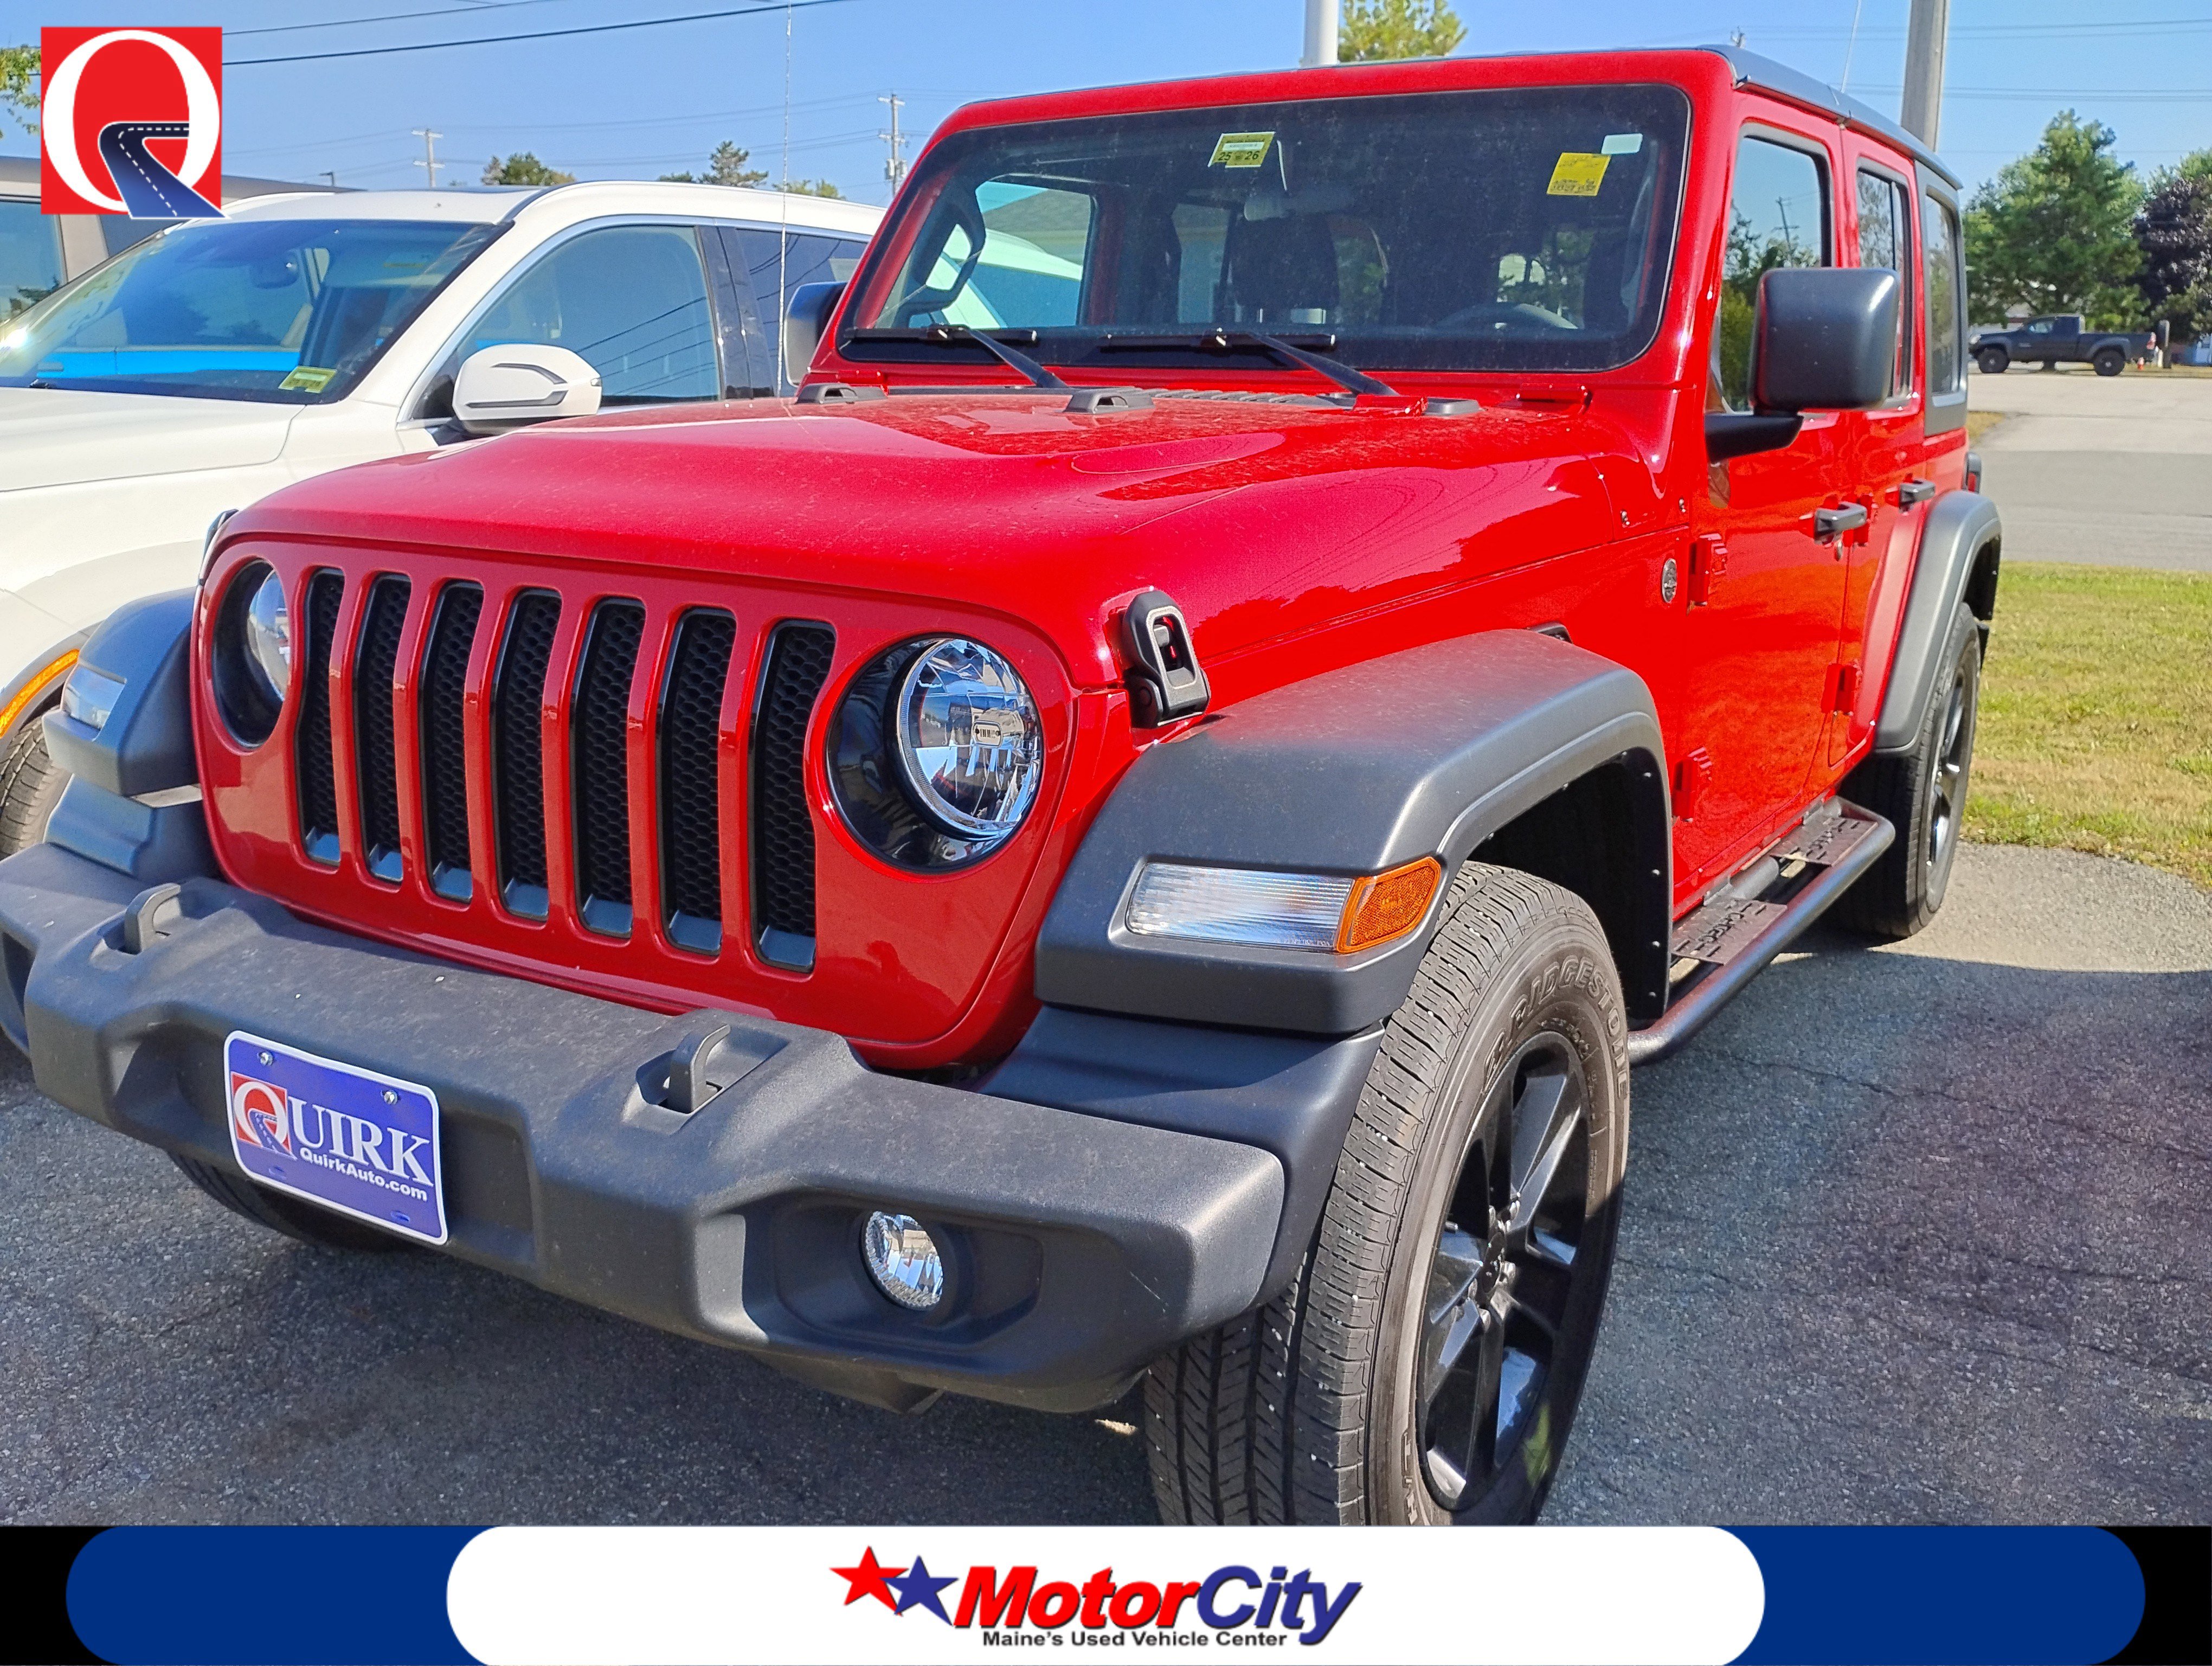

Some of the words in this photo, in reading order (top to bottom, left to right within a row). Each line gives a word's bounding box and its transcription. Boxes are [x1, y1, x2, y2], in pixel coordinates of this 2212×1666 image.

[1218, 152, 1232, 161] 25
[1245, 150, 1260, 160] 26
[234, 1081, 434, 1187] QUIRK
[300, 1147, 428, 1201] QuirkAuto.com
